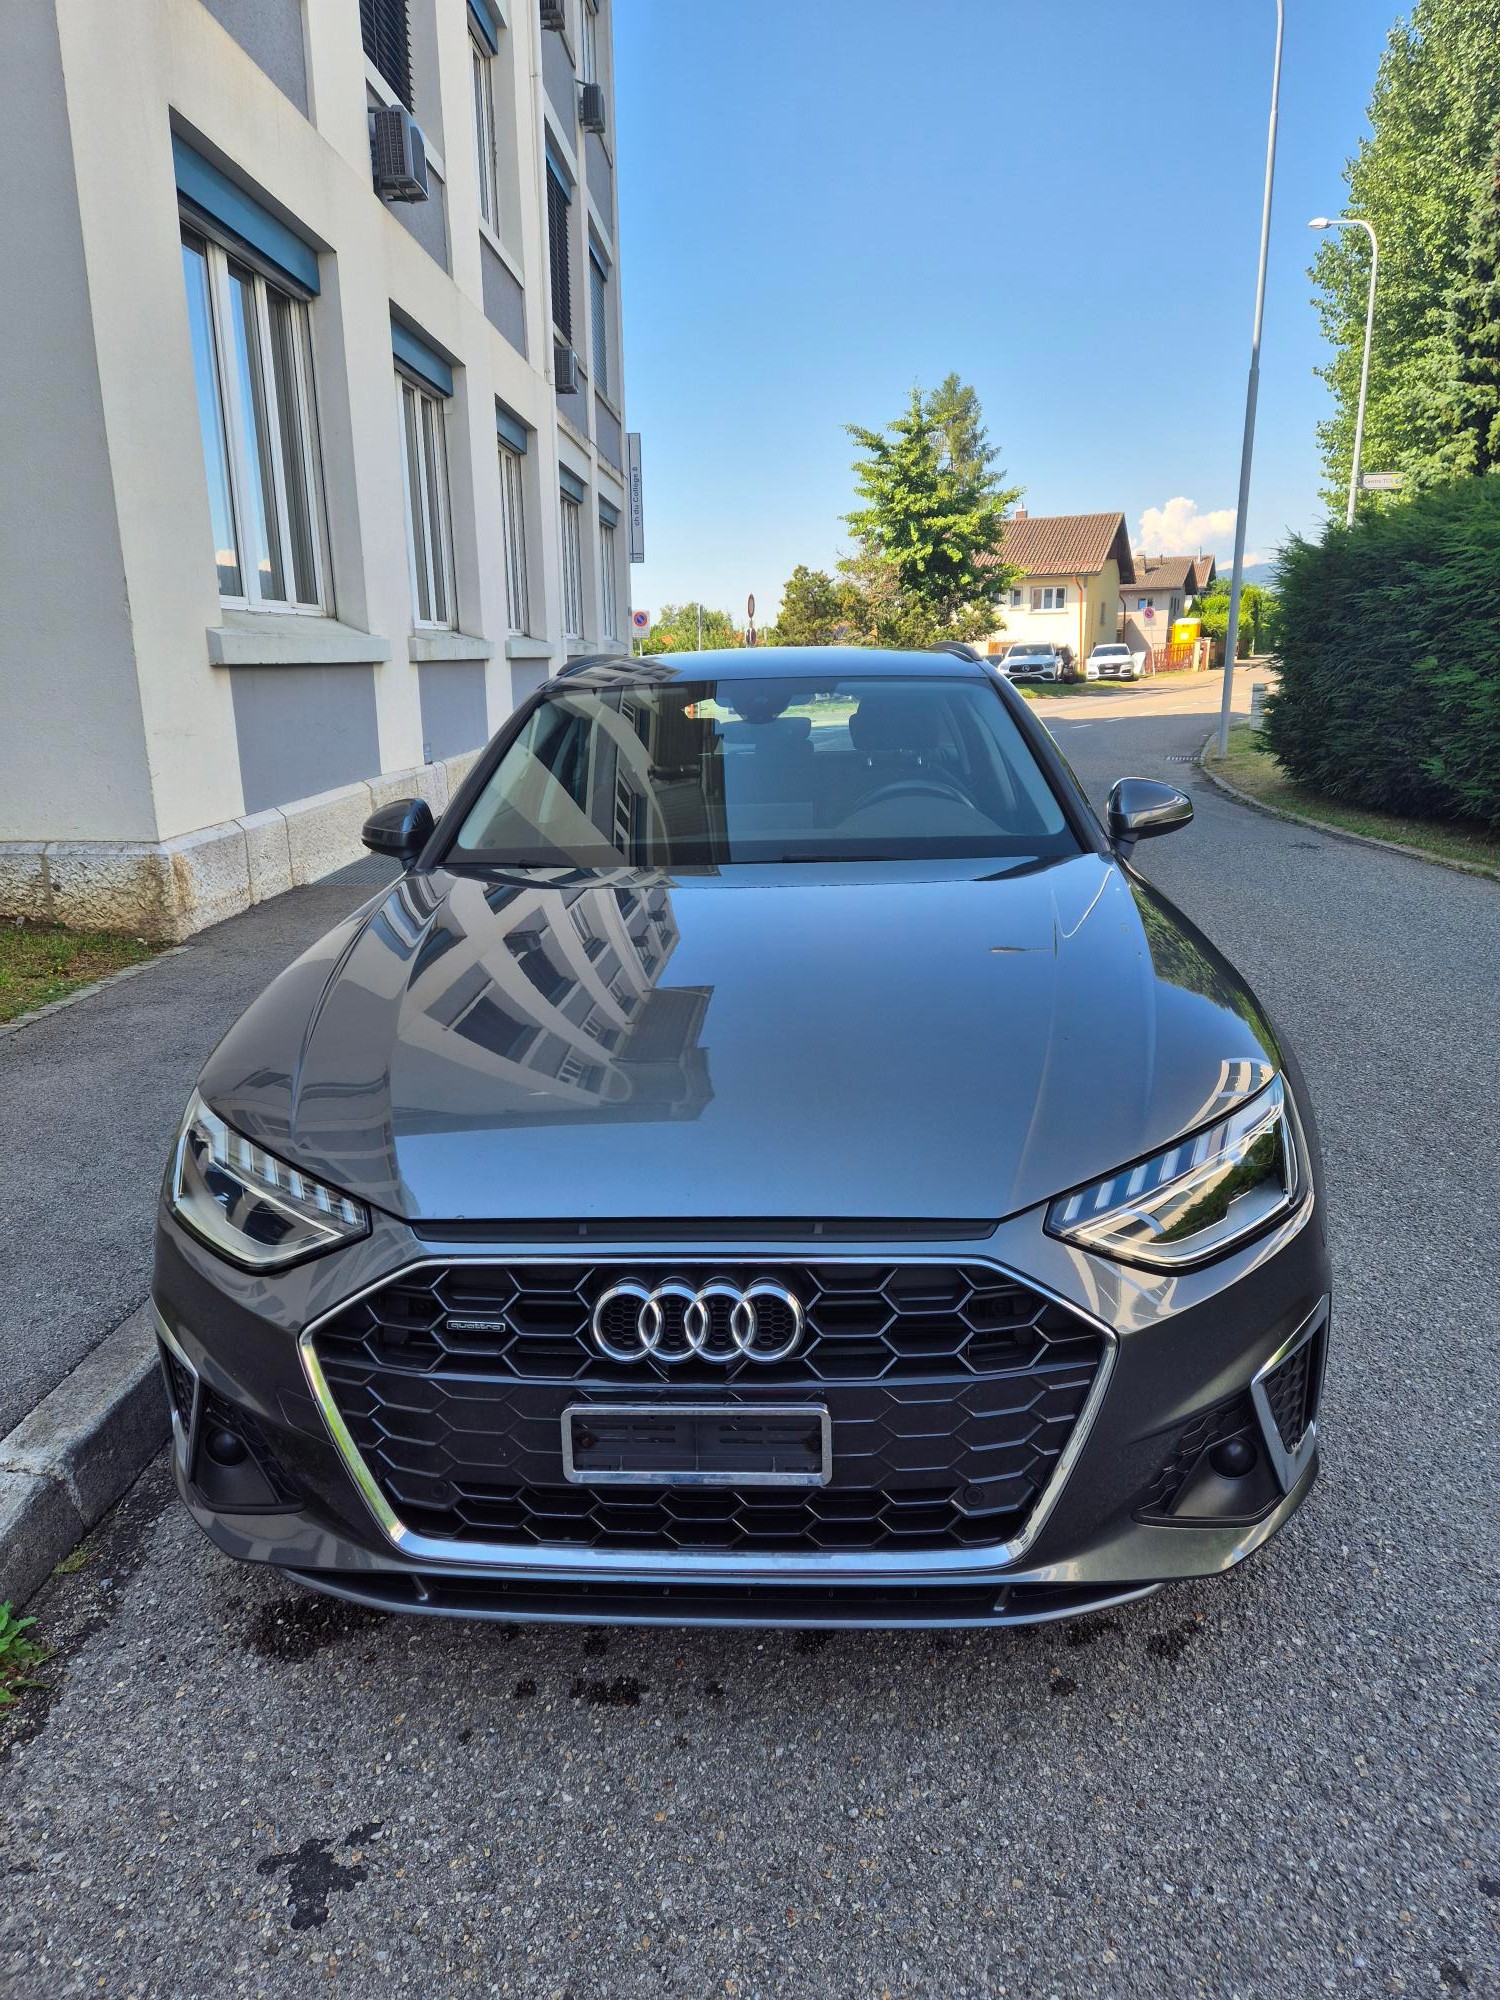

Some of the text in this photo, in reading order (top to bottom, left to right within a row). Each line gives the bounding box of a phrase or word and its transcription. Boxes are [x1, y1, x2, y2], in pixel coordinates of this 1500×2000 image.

[633, 504, 639, 515] du
[633, 516, 640, 526] ch
[450, 1322, 501, 1331] quattro
